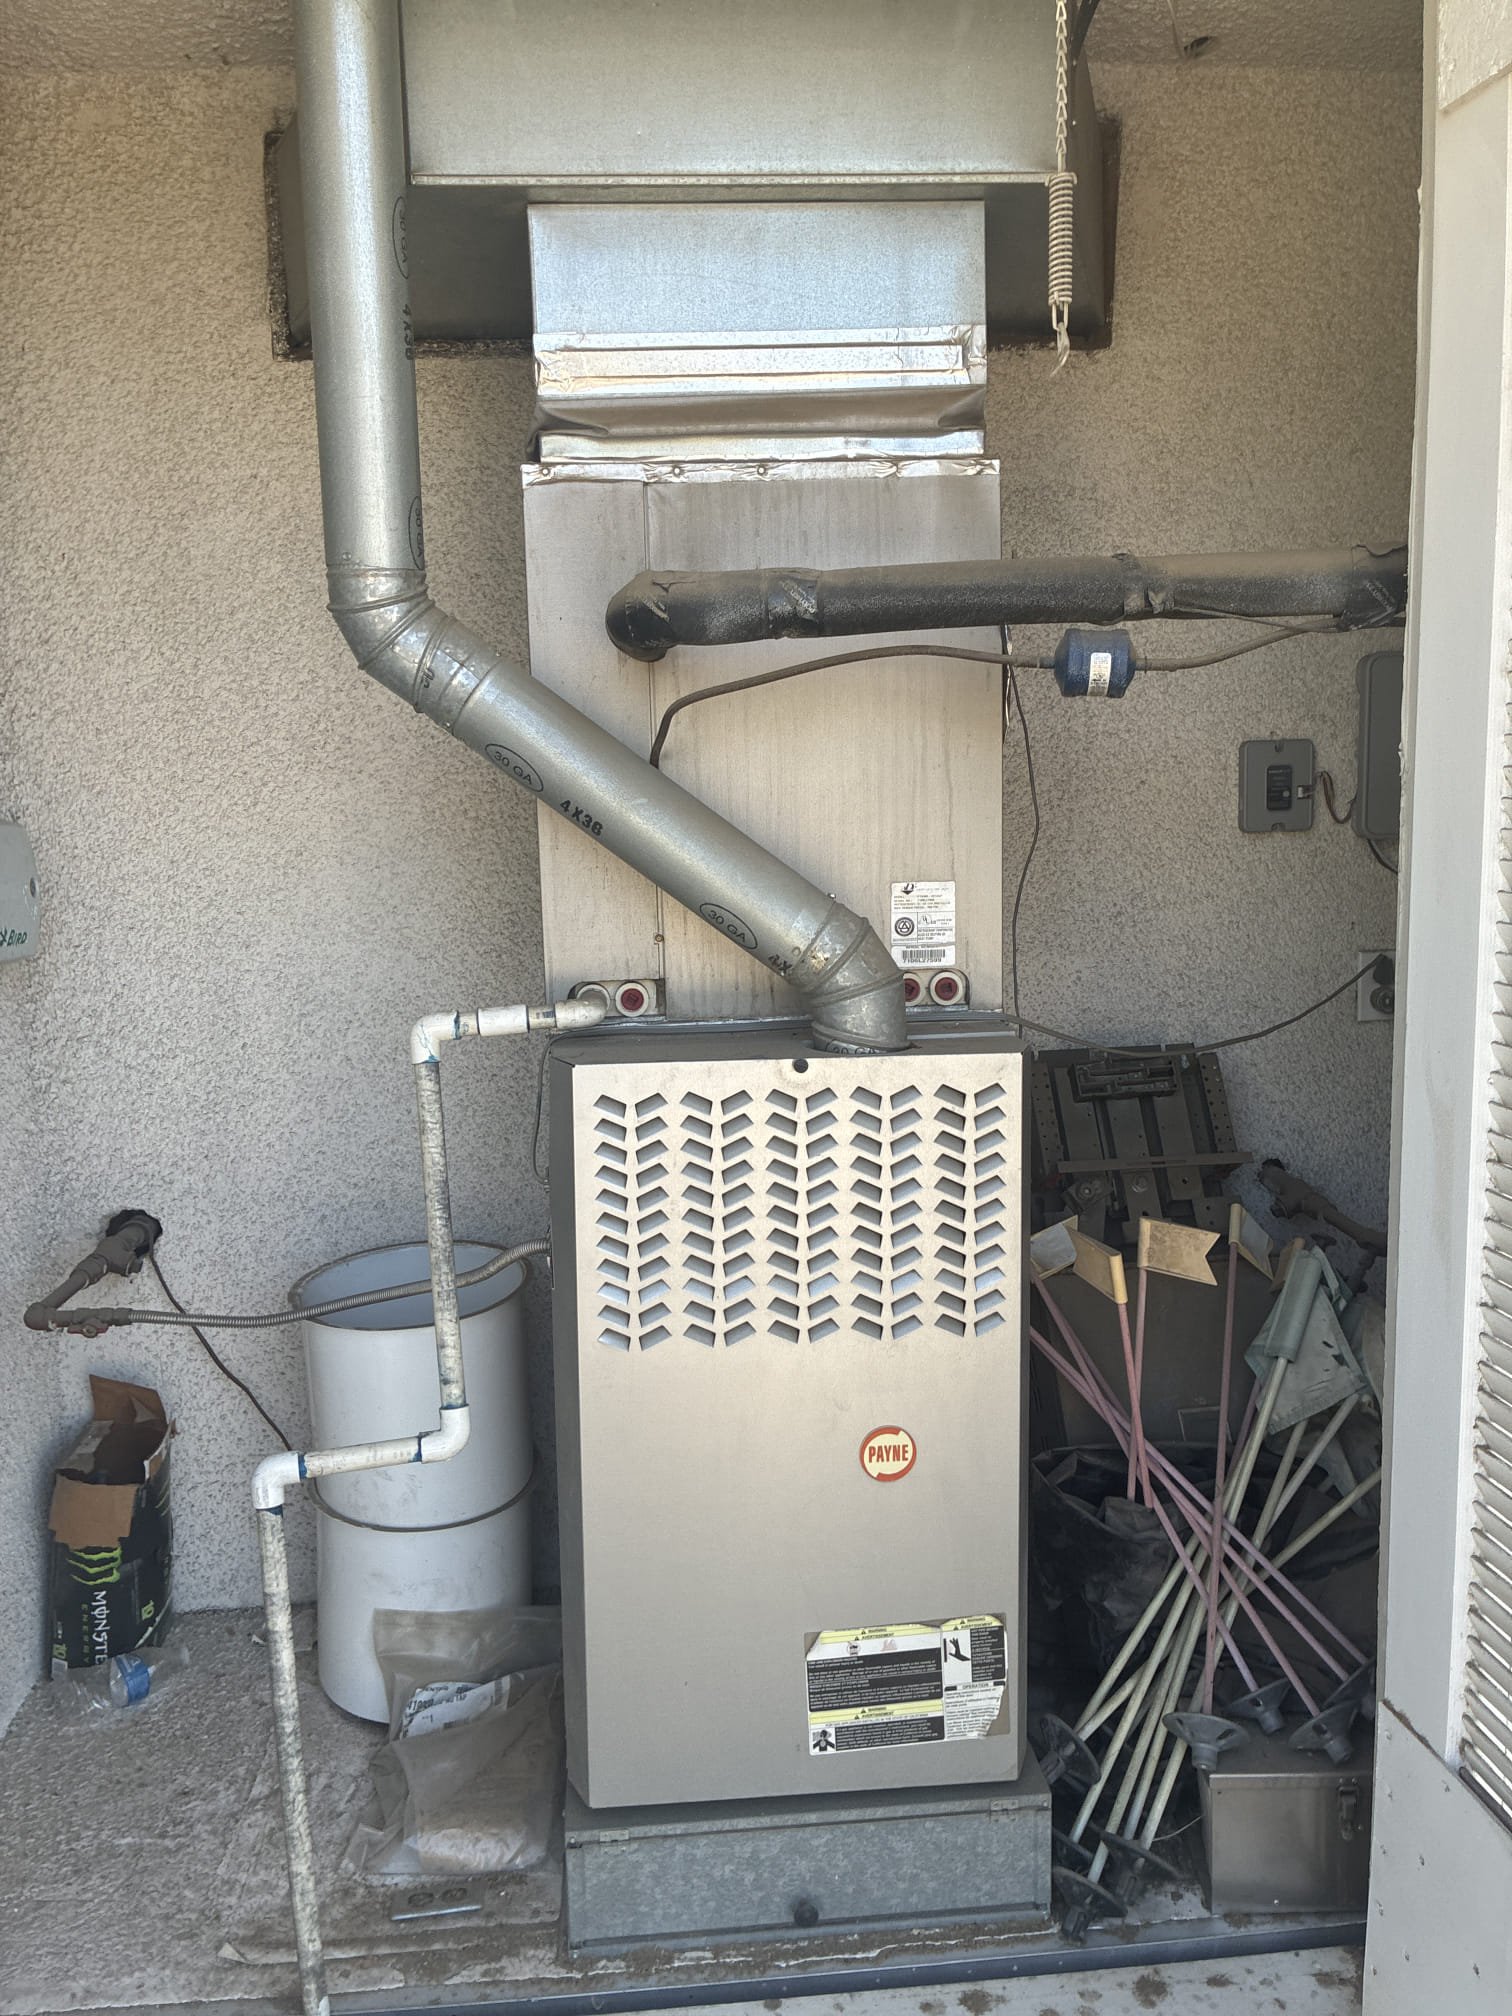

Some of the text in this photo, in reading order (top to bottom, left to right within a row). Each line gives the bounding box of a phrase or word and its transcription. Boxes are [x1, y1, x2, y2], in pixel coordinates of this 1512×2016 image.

[494, 751, 532, 785] 30 GA
[708, 910, 746, 943] 30 GA
[868, 1444, 909, 1463] PAYNE
[91, 1590, 111, 1665] MONSTE
